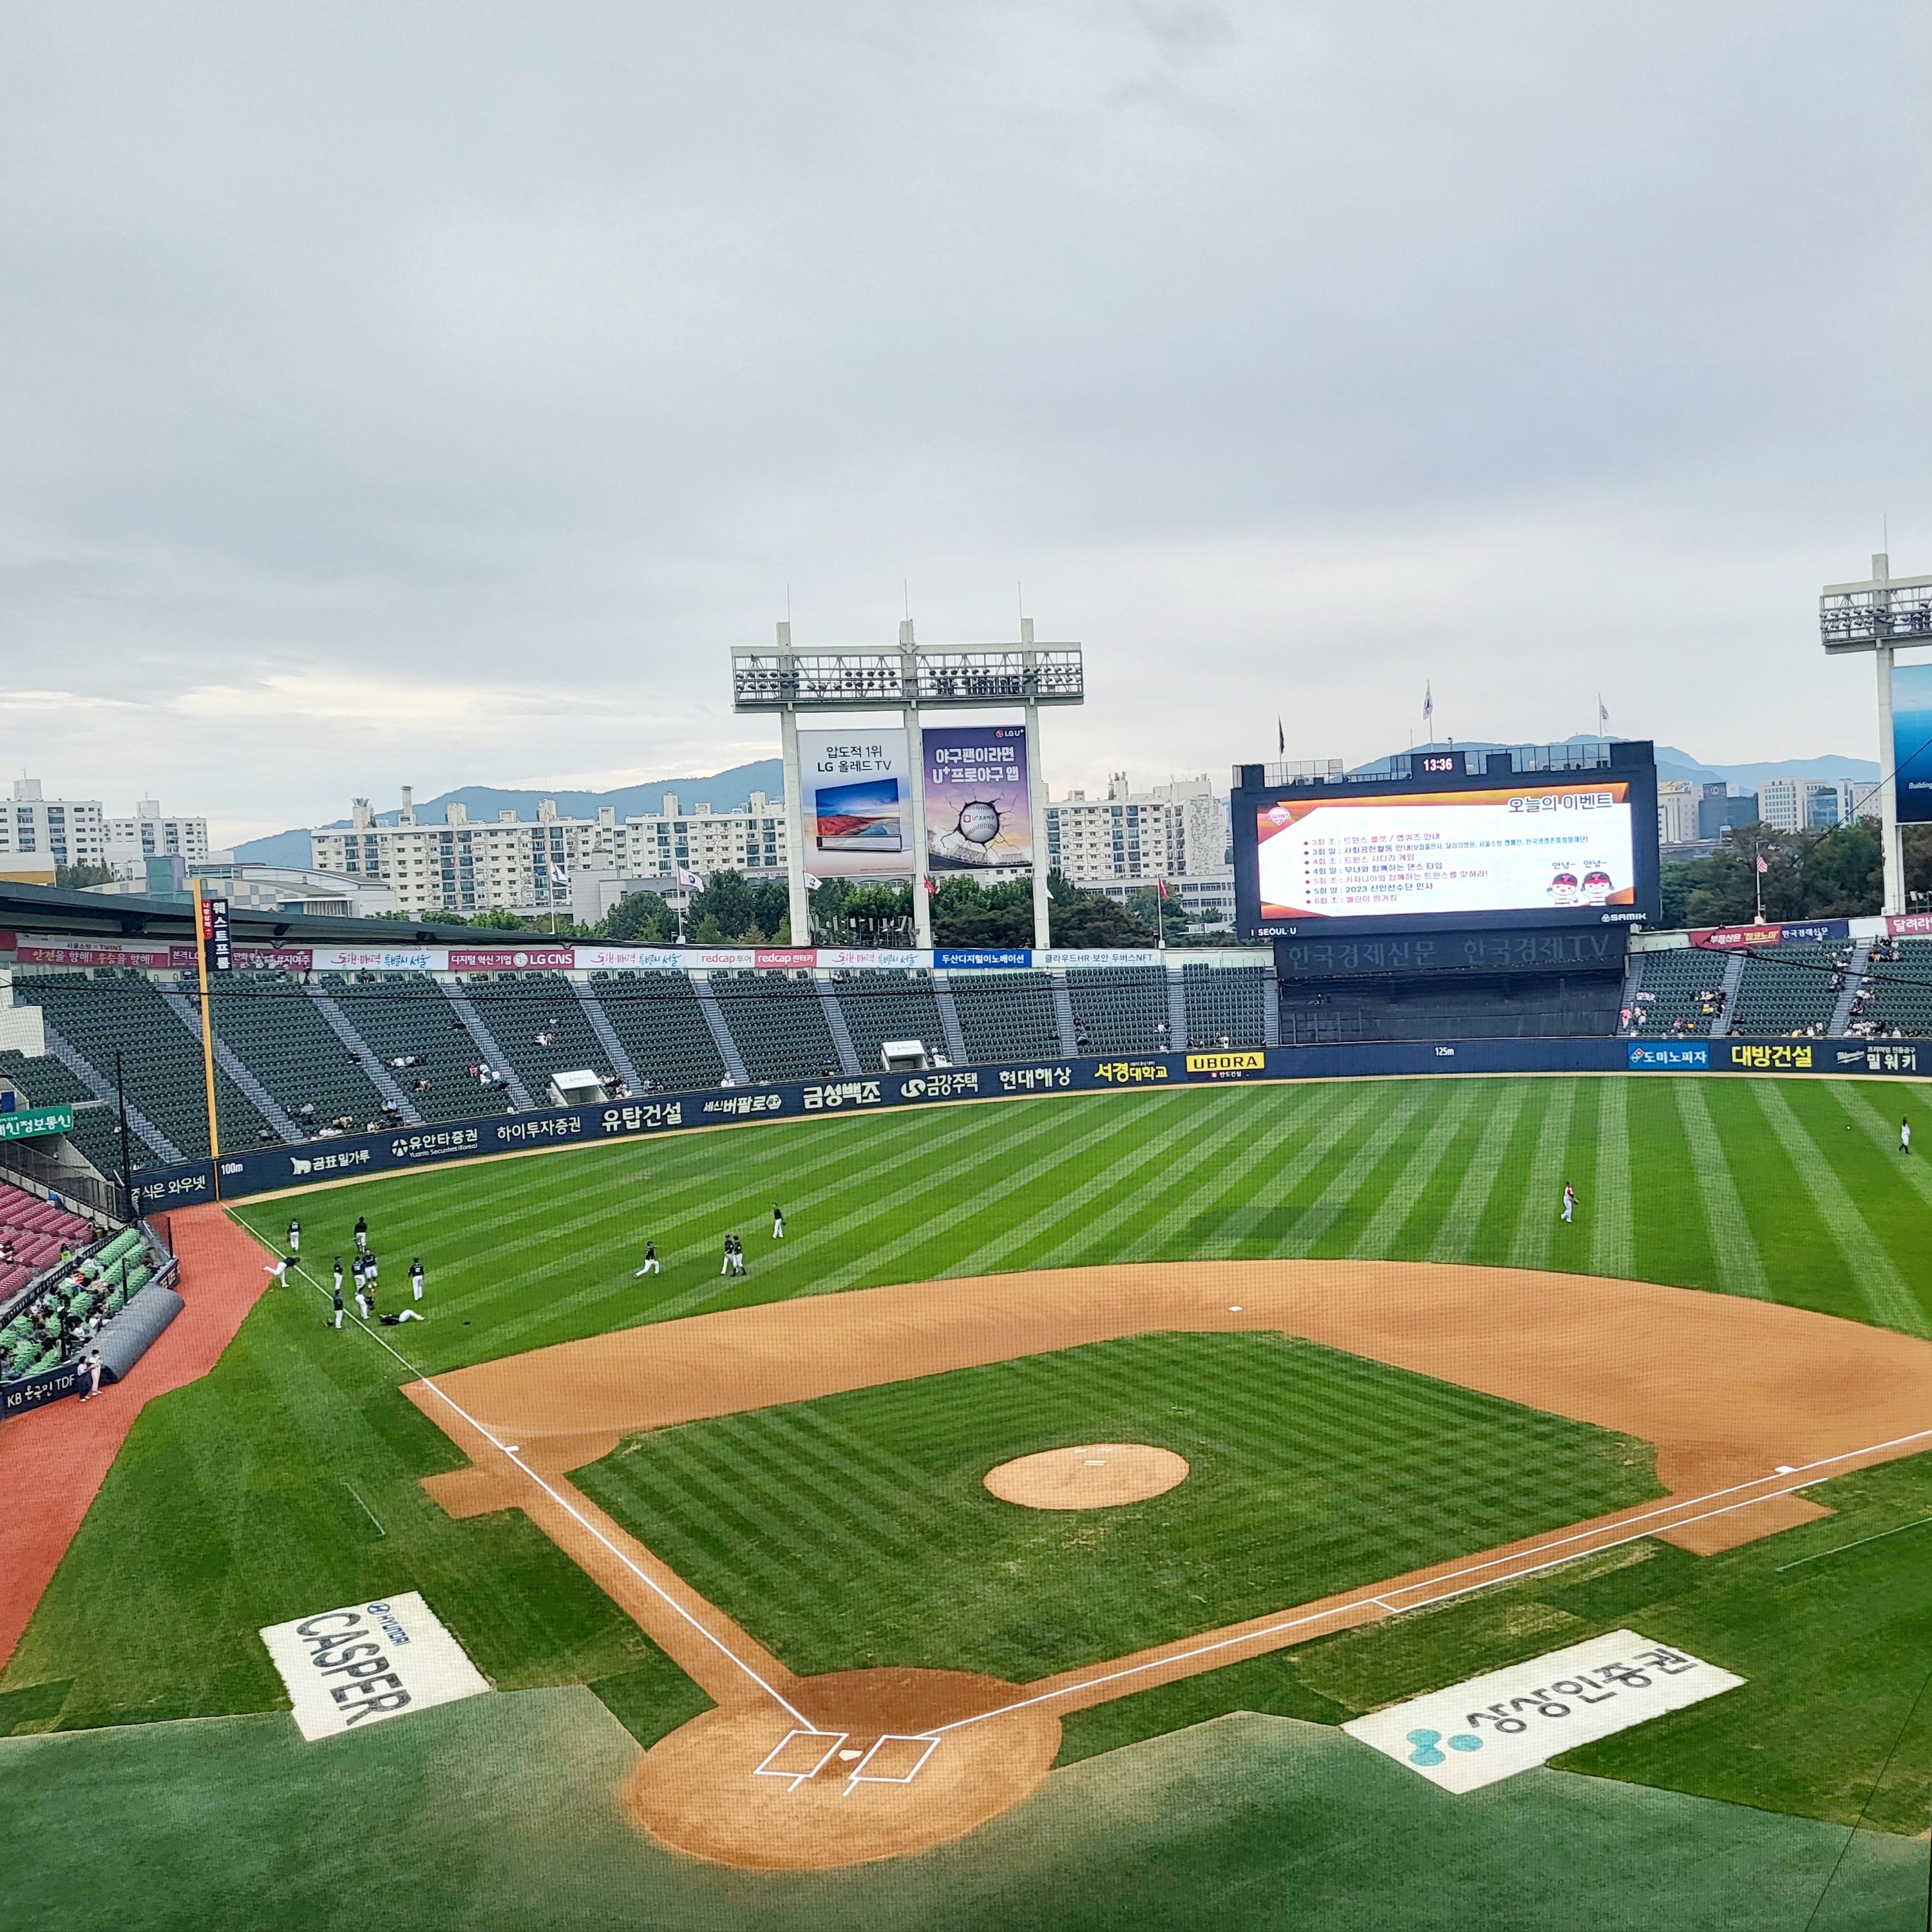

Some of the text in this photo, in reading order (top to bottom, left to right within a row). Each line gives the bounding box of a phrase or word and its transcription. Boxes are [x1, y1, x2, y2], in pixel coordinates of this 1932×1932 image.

[826, 745, 882, 759] 압도적 1위
[936, 746, 1014, 764] 야구팬이라면
[817, 760, 891, 772] LG 올레드 TV
[1423, 758, 1453, 772] 13:36
[1006, 766, 1019, 781] 앱
[1508, 793, 1612, 813] 오늘의 이벤트
[1344, 845, 1392, 855] 사회공헌활동
[1399, 853, 1415, 862] 게임
[1372, 864, 1405, 873] 함께하는
[1345, 875, 1385, 884] 키자니아와
[1388, 873, 1421, 881] 함께하는
[1424, 871, 1457, 880] 트윈스를
[1370, 884, 1412, 893] 신인선수단
[1610, 913, 1647, 922] SAMIK
[1893, 916, 1932, 933] 달려라
[213, 902, 231, 969] 웨스트프롬
[1710, 933, 1741, 945] 부동산은
[1781, 927, 1828, 939] 한국경제신문
[32, 951, 153, 965] 안전을 향해! 우승을 향해!
[451, 954, 573, 965] 디지털 혁신 기업 LG CNS
[639, 953, 660, 966] 특별시
[662, 953, 682, 966] 서울
[701, 954, 735, 964] redcap
[758, 952, 813, 964] redcap 렌터카
[942, 954, 1025, 964] 두산디지털이노베이션
[1288, 934, 1609, 971] 한국경제신문 한국경제TV
[276, 955, 311, 965] #지여주
[384, 954, 408, 967] 특별시
[410, 954, 431, 968] 서울
[878, 954, 898, 965] 특별시
[900, 954, 919, 966] 서울
[1435, 1046, 1455, 1056] 125m
[1643, 1050, 1707, 1064] 도미노피자
[1731, 1045, 1813, 1068] 대방건설
[1194, 1056, 1258, 1069] UBORA
[1867, 1054, 1916, 1071] 밀워키
[999, 1066, 1072, 1090] 현대해상
[1094, 1063, 1168, 1083] 서경대학교
[926, 1072, 978, 1096] 금강주택
[803, 1081, 881, 1109] 금성백조
[601, 1102, 683, 1132] 유탑건설
[497, 1116, 581, 1142] 하이투자증권
[409, 1128, 478, 1150] 유안타증권
[409, 1142, 478, 1159] Yuanta Securities (Korea)
[221, 1163, 243, 1175] 100m
[168, 1175, 206, 1194] 와우넷
[8, 1374, 75, 1408] KB 온국민 TDF
[376, 1614, 412, 1647] HYUNDAI
[296, 1613, 412, 1726] CASPER
[1465, 1648, 1698, 1734] 상상인증권
